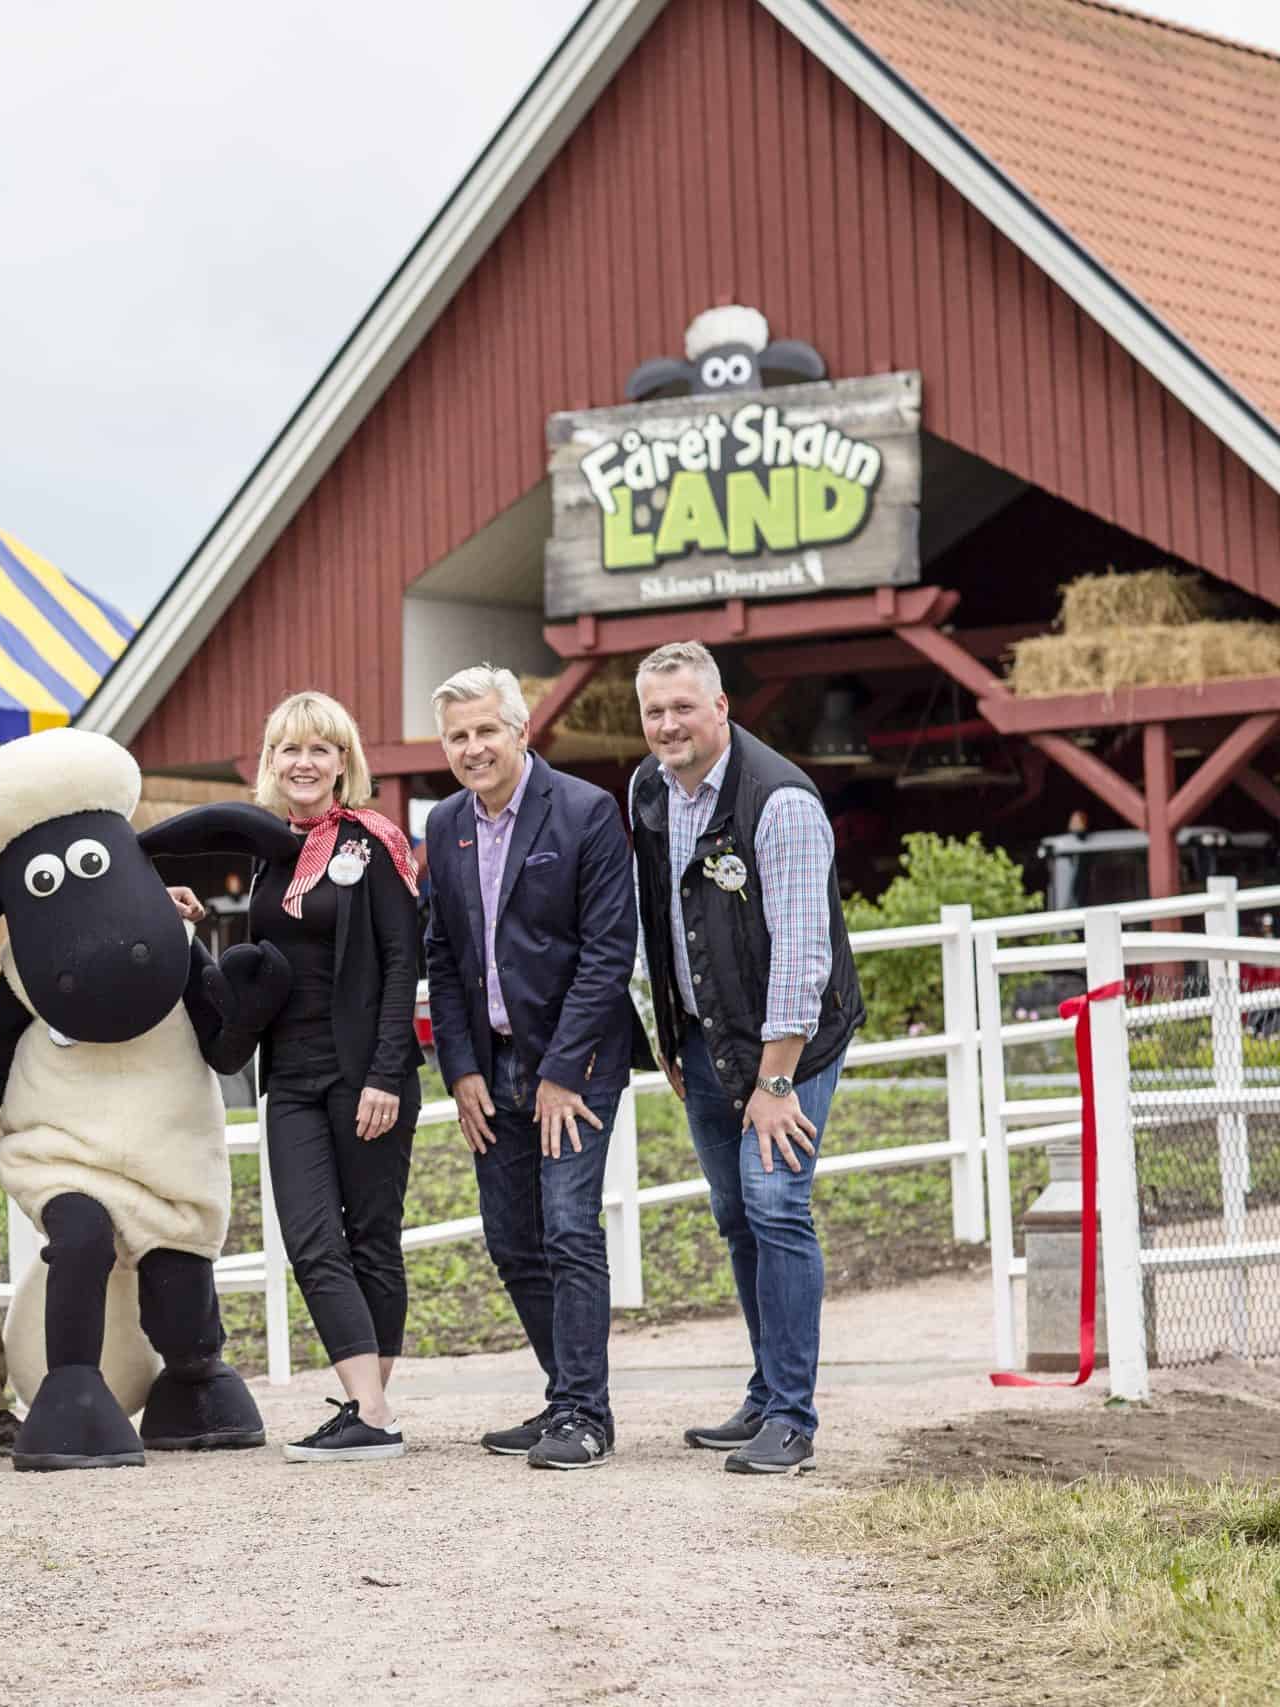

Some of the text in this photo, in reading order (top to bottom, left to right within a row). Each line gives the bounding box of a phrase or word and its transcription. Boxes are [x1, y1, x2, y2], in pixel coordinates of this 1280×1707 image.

[581, 404, 880, 513] Fåret Shaun
[603, 466, 867, 569] LAND
